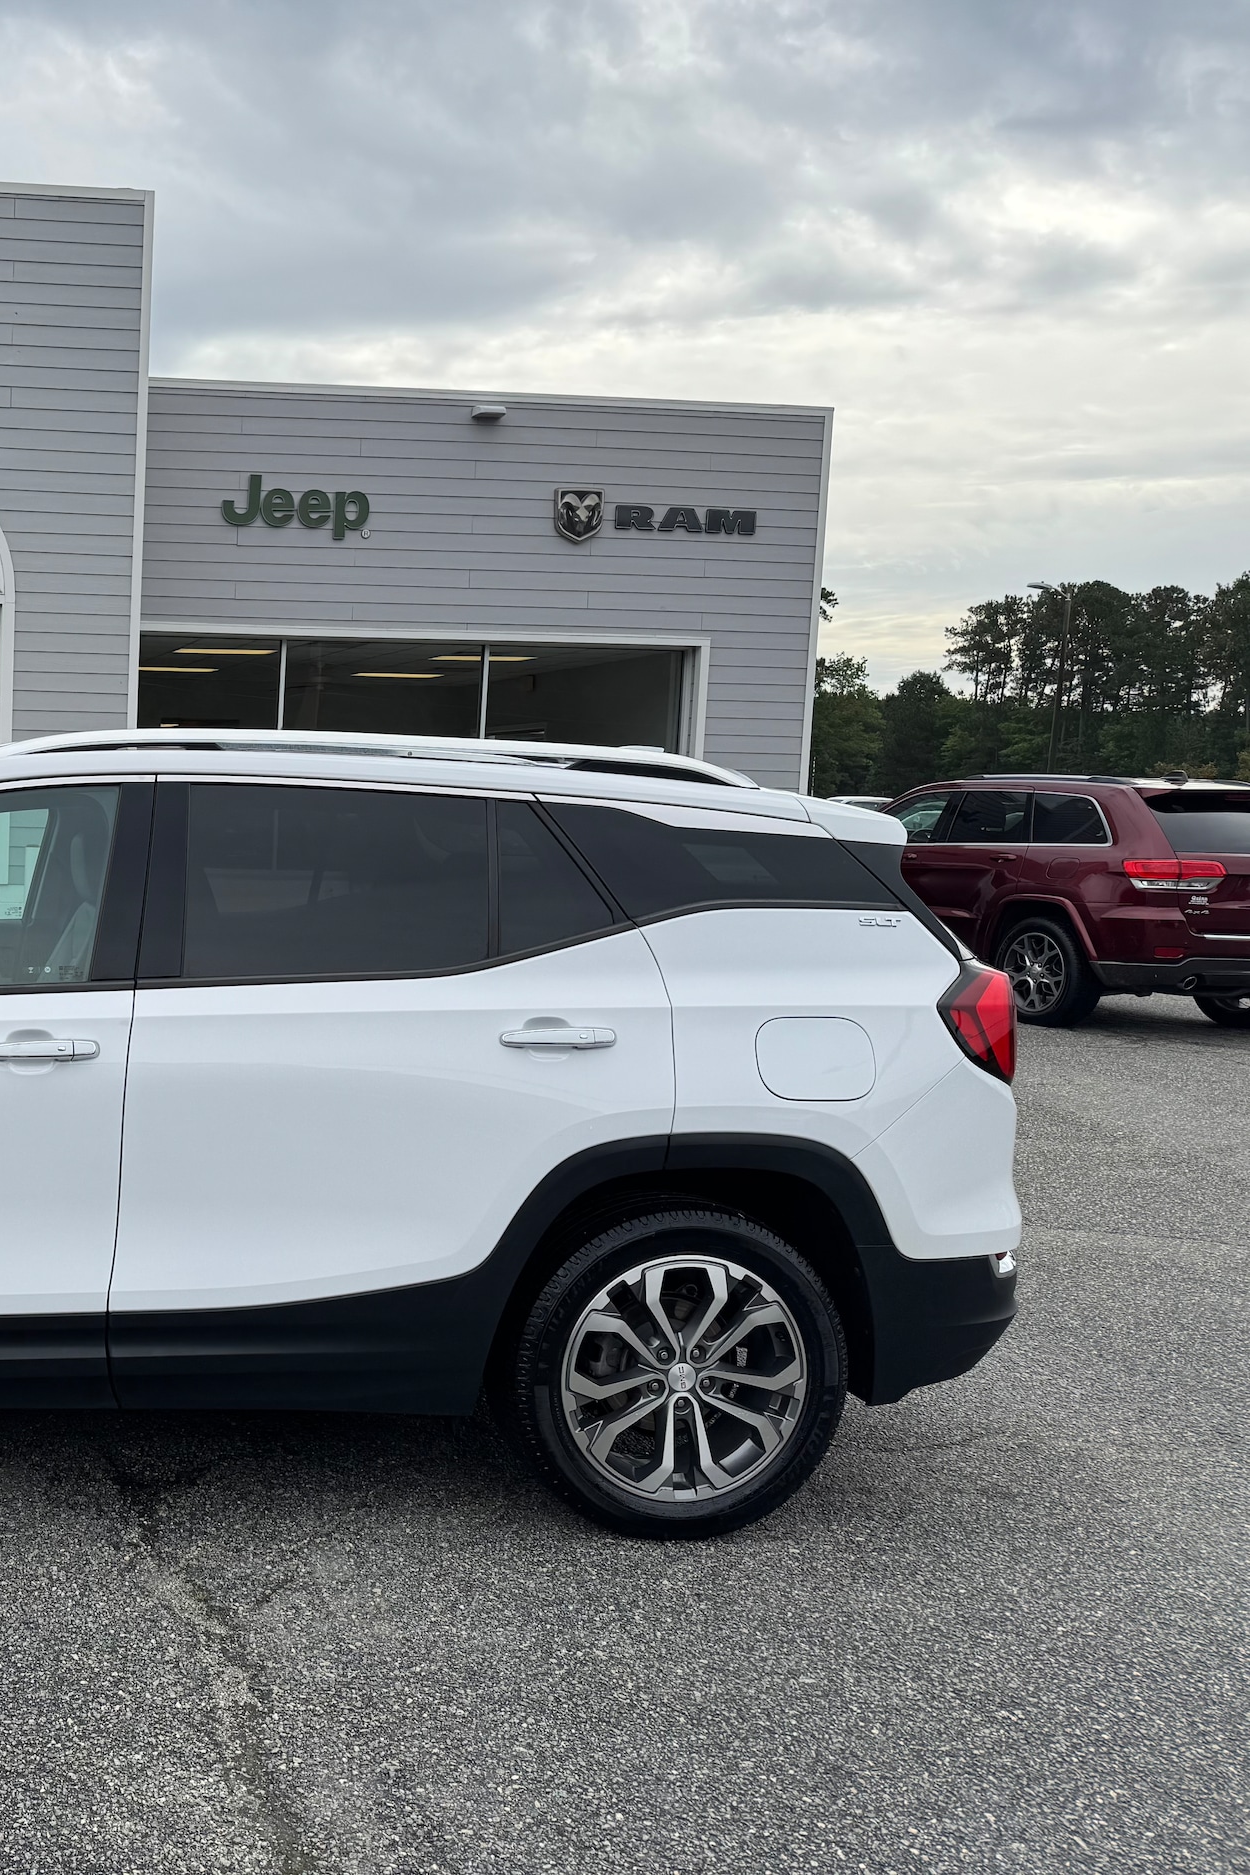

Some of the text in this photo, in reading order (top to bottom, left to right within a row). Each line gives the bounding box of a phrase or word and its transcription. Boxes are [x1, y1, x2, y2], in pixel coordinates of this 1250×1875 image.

[221, 474, 370, 540] Jeep
[614, 504, 758, 535] RAM
[858, 917, 901, 928] SLT
[678, 1366, 687, 1390] GMC
